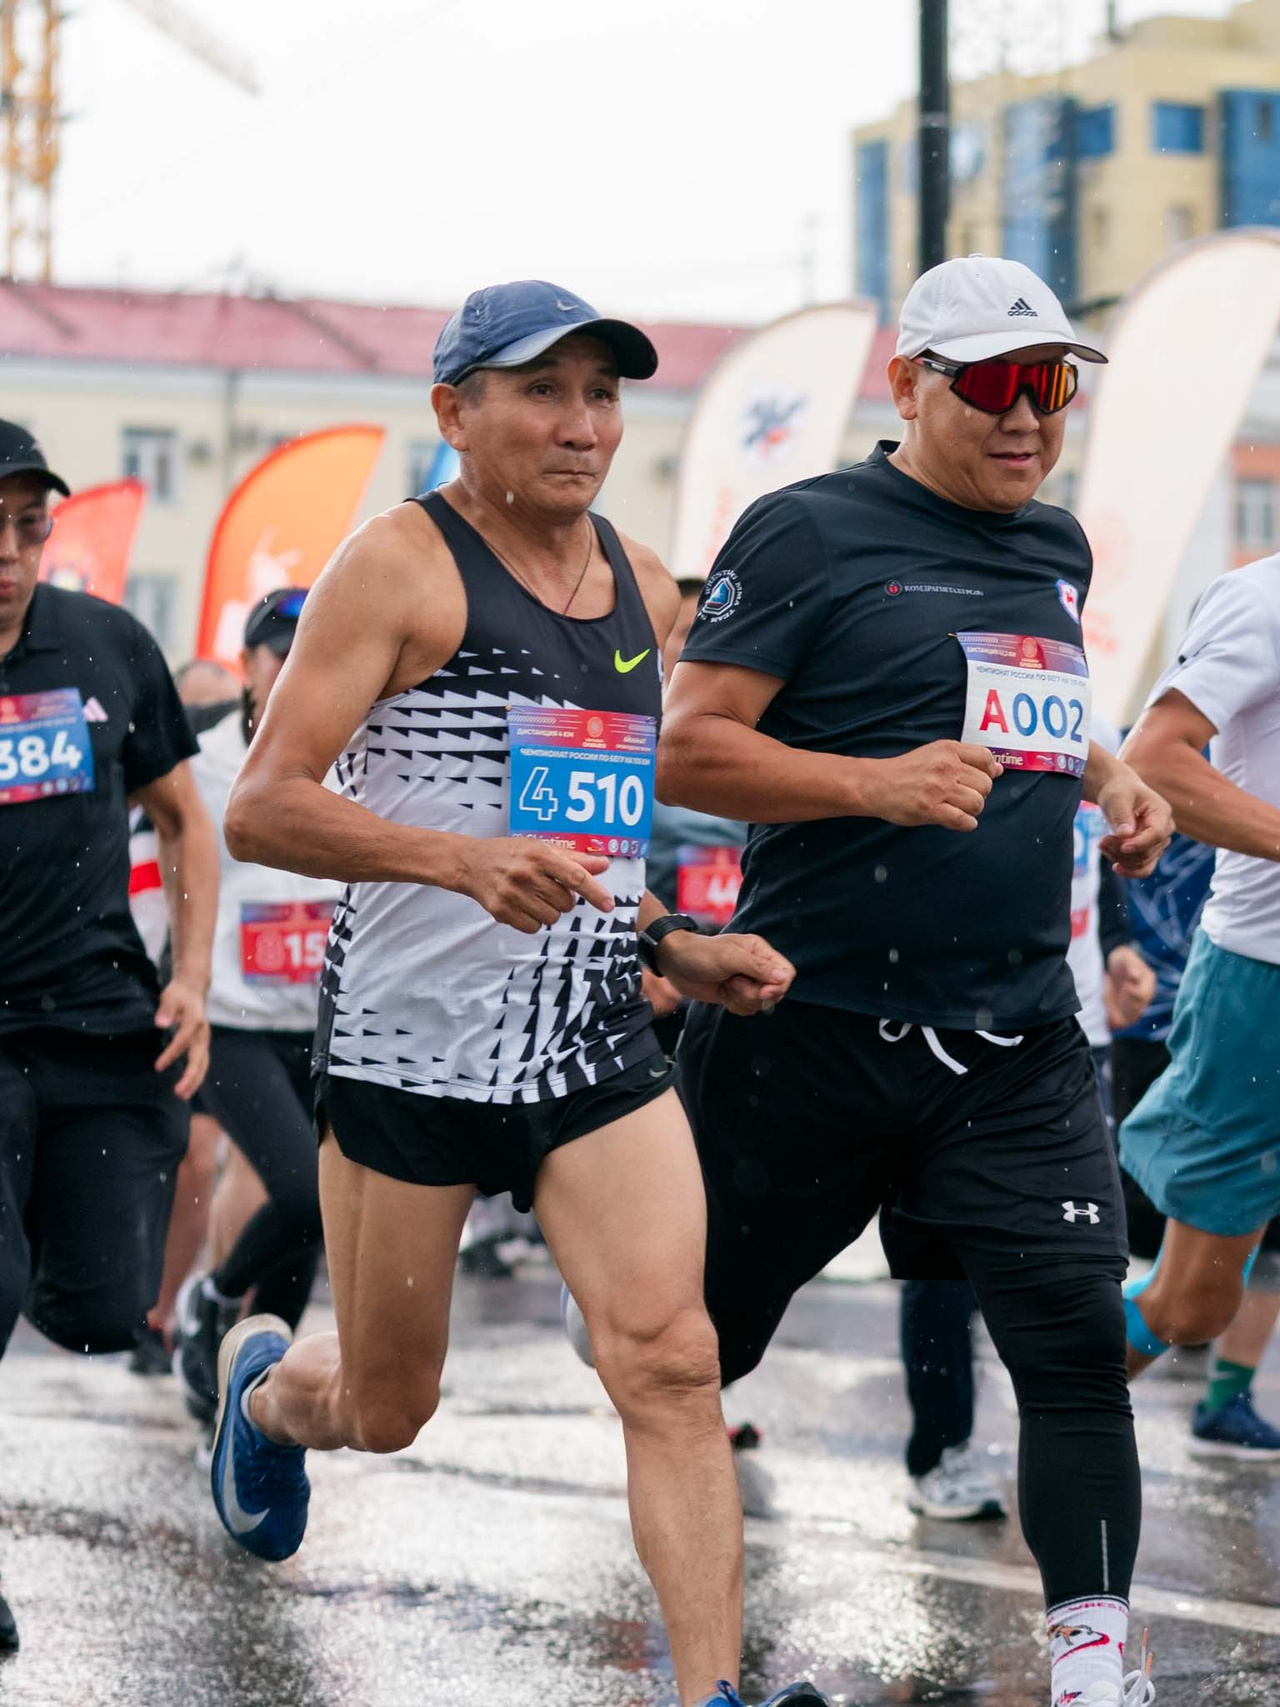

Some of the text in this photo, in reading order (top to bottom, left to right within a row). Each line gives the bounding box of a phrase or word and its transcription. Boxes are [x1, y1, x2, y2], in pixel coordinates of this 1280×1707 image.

[569, 751, 599, 761] РОССИИ
[599, 754, 610, 762] ПО
[991, 751, 1024, 766] intime
